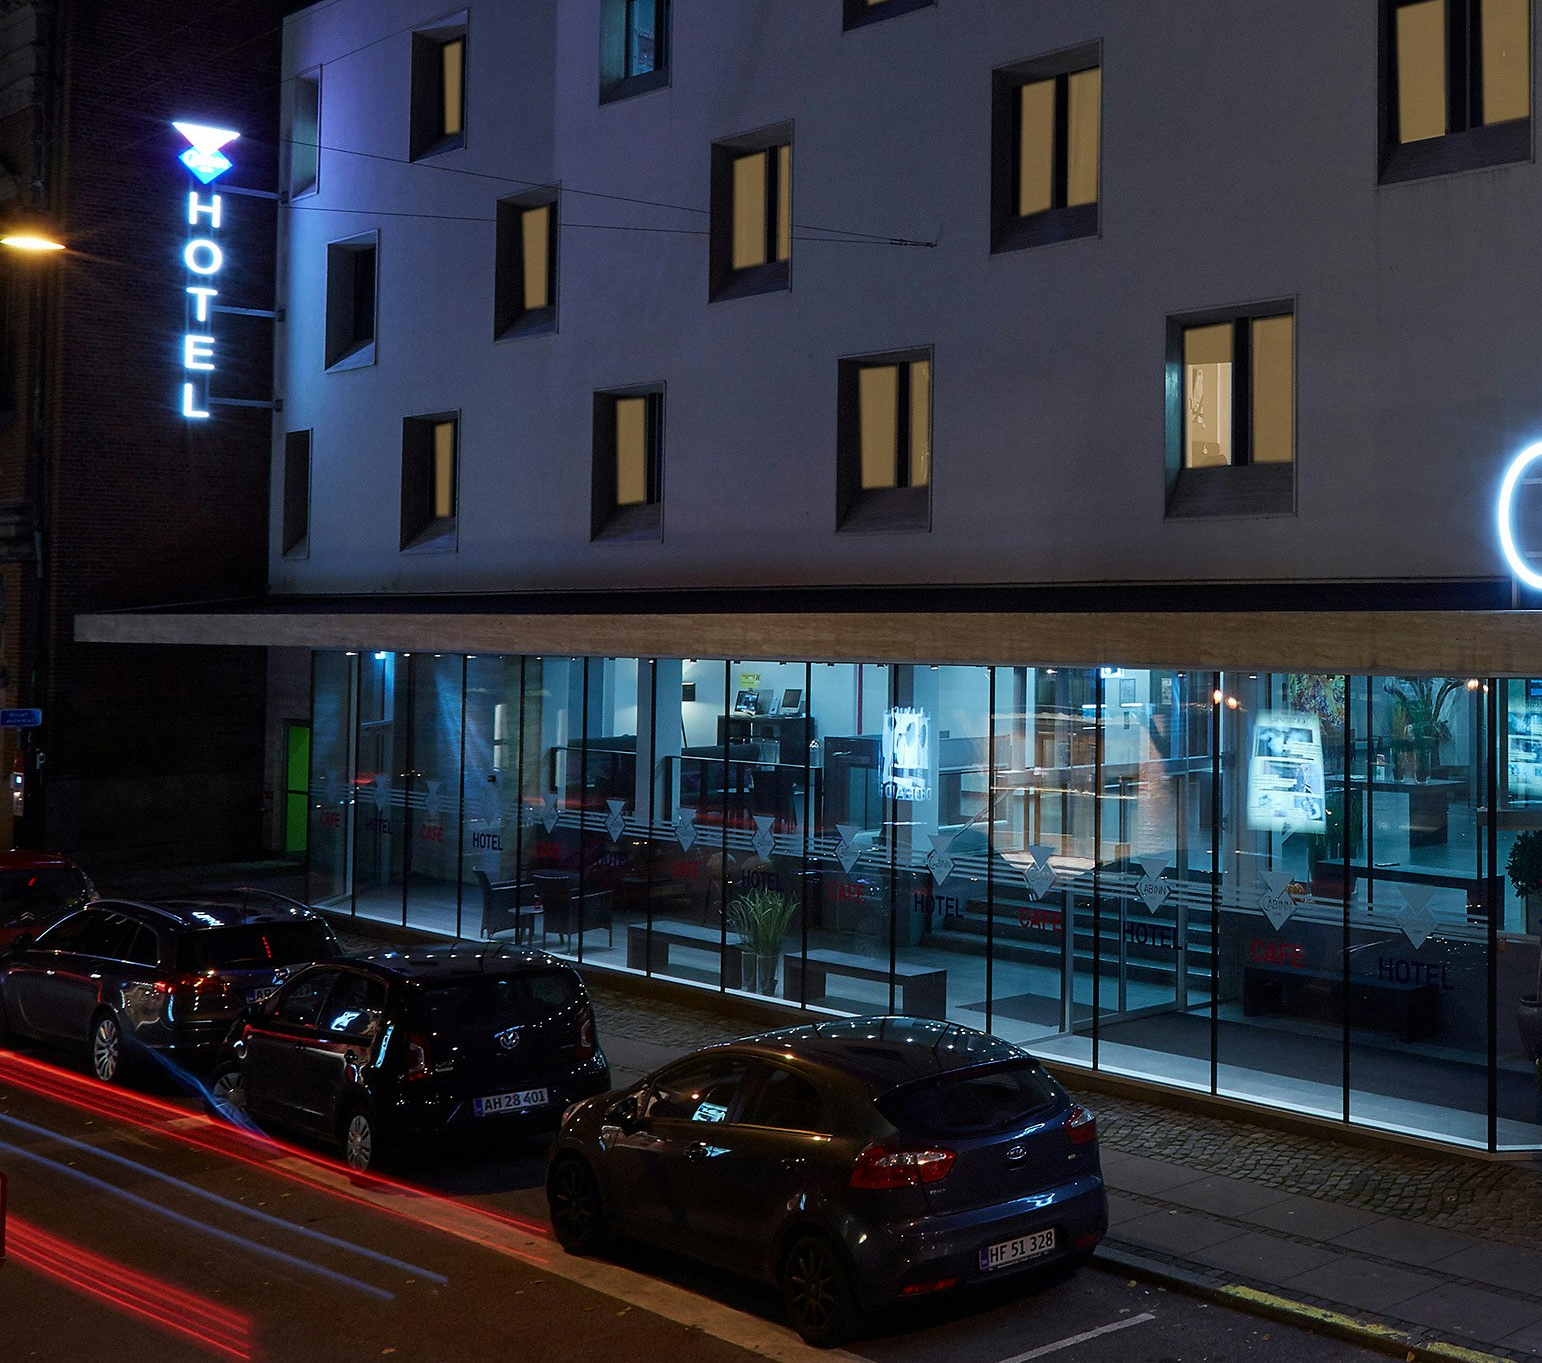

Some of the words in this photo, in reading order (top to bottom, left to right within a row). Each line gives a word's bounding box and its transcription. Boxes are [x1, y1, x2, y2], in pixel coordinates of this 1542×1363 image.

[184, 191, 224, 418] HOTEL
[472, 831, 504, 851] HOTEL
[829, 880, 865, 904] CAFE
[913, 892, 964, 919] HOTEL
[1019, 907, 1066, 934] CAFE
[1122, 922, 1183, 951] HOTEL
[1250, 938, 1306, 970] CAFE
[1377, 956, 1455, 992] HOTEL
[484, 1097, 502, 1112] AH
[504, 1093, 521, 1107] 28
[523, 1090, 546, 1105] 401
[989, 1244, 1008, 1263] HF
[1010, 1240, 1026, 1258] 51
[1029, 1230, 1054, 1253] 328
